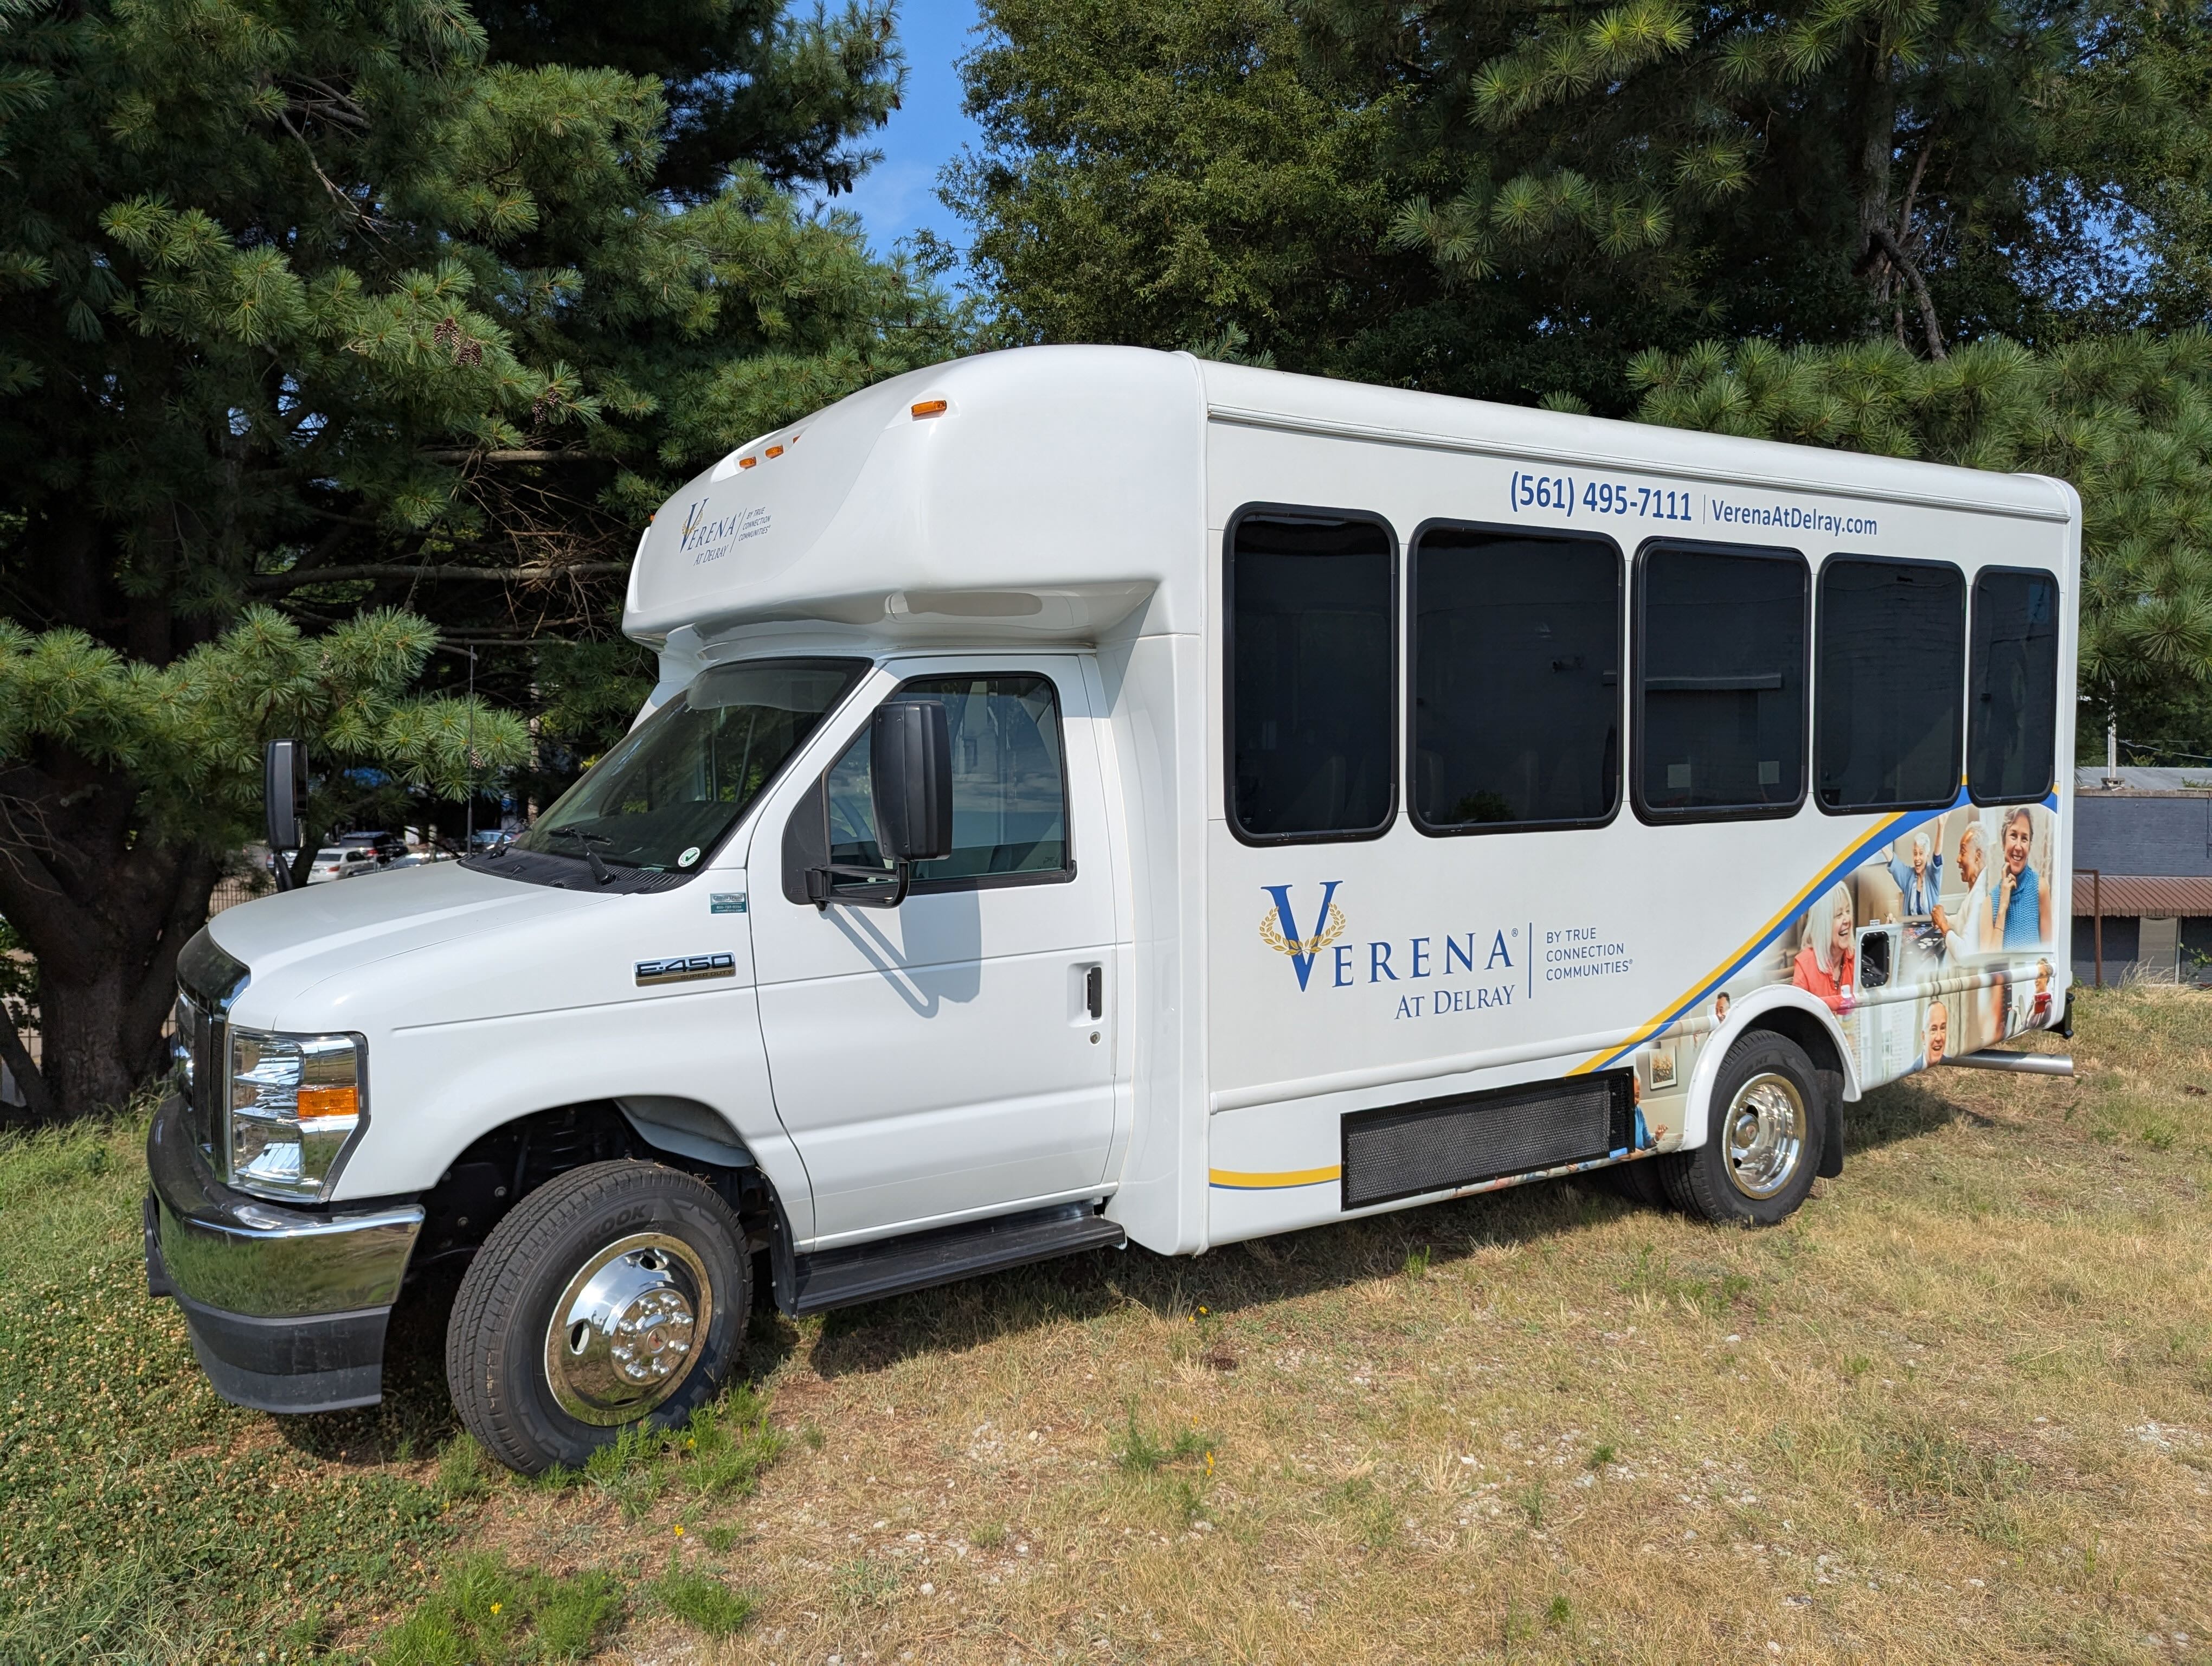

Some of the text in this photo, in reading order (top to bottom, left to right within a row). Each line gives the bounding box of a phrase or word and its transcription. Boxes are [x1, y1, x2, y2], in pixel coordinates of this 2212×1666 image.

[747, 507, 766, 520] BY TRUE
[1511, 471, 1877, 537] (561) 495-7111 VerenaAtDelray.com
[743, 515, 771, 530] CONNECTION
[693, 544, 729, 566] AT DELRAY
[1547, 927, 1596, 944] BY TRUE
[1546, 943, 1624, 962] CONNECTION
[637, 954, 732, 977] E-450
[1394, 985, 1515, 1019] AT DELRAY
